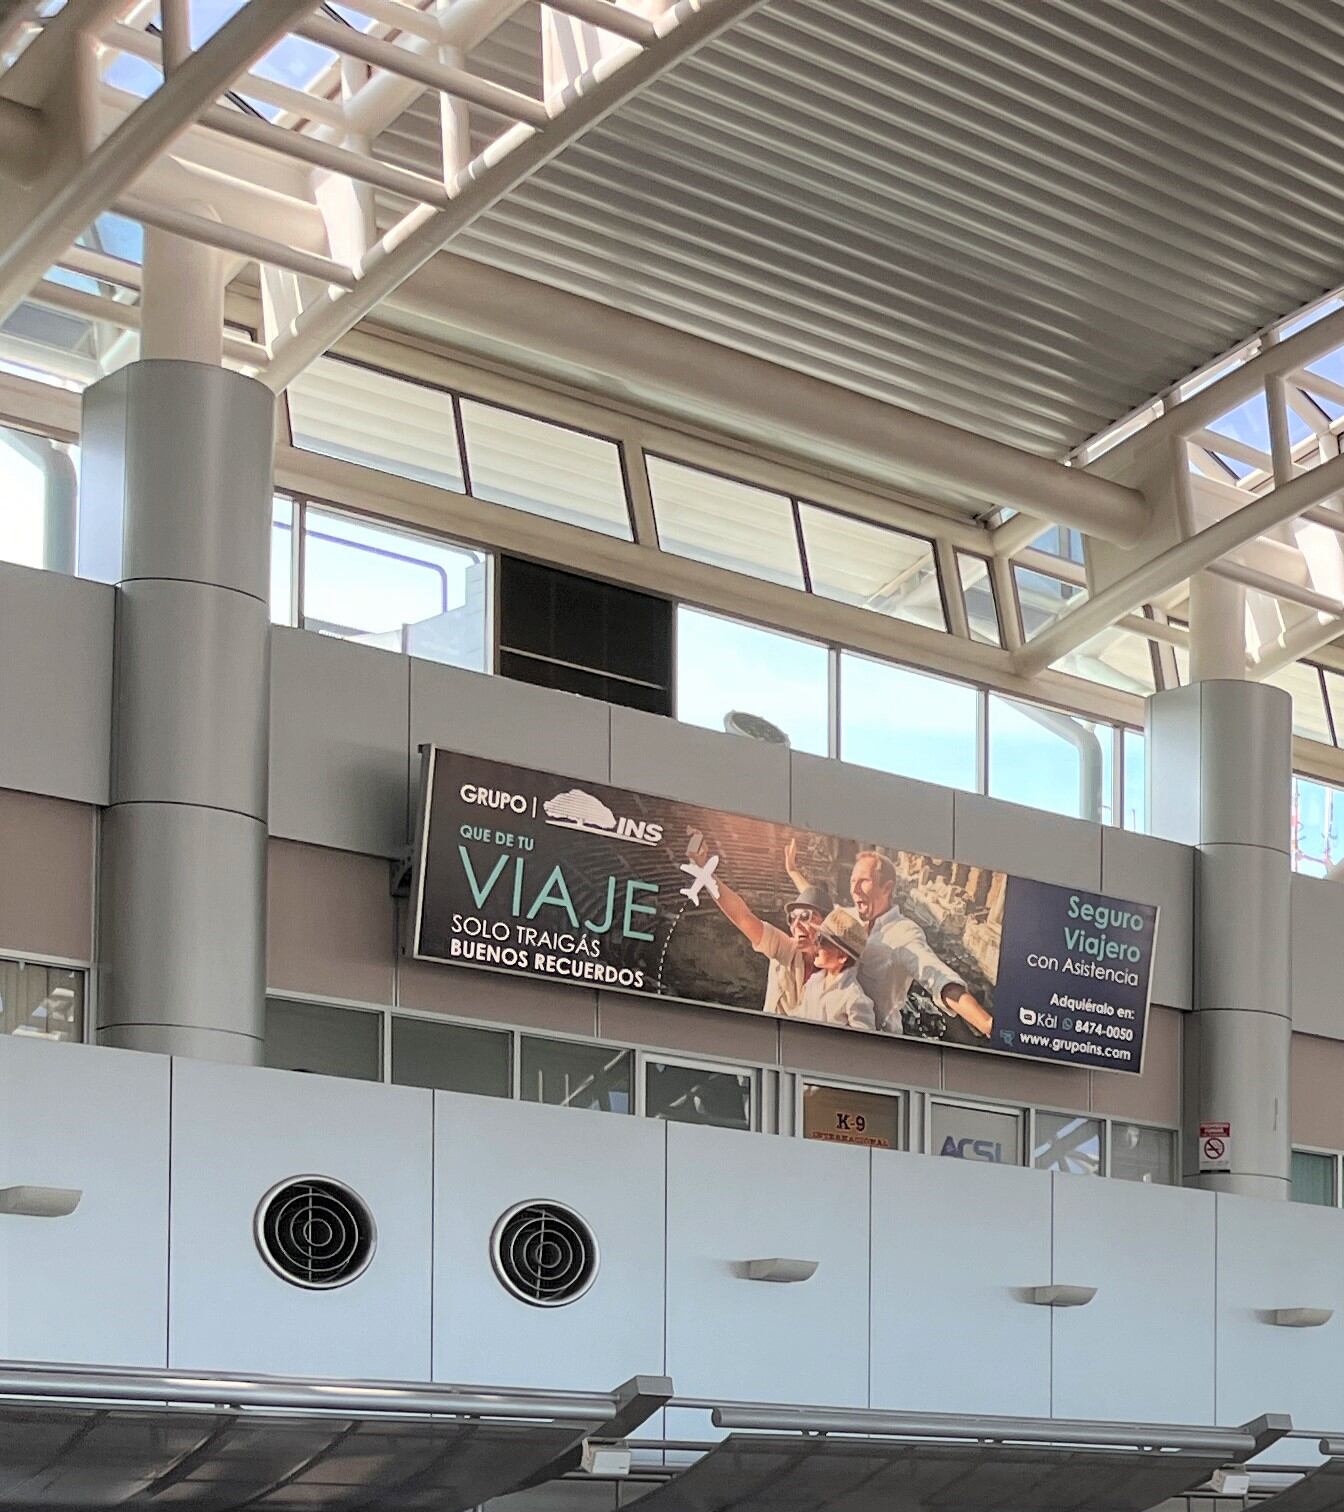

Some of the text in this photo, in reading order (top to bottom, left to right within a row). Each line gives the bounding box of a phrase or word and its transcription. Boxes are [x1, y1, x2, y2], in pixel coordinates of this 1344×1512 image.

[460, 784, 664, 843] GRUPO INS
[460, 824, 534, 851] QUE DE TU
[458, 845, 660, 942] VIAJE
[1067, 895, 1144, 932] Seguro
[451, 913, 601, 958] SOLO TRAIGÁS
[1064, 926, 1141, 963] Viajero
[450, 938, 645, 988] BUENOS RECUERDOS
[1027, 953, 1139, 987] con Asistencia
[1050, 993, 1136, 1020] Adquiéralo en:
[1019, 1032, 1132, 1061] www.grupoins.com
[1074, 1019, 1134, 1042] 8474-0050
[836, 1112, 867, 1132] K-9
